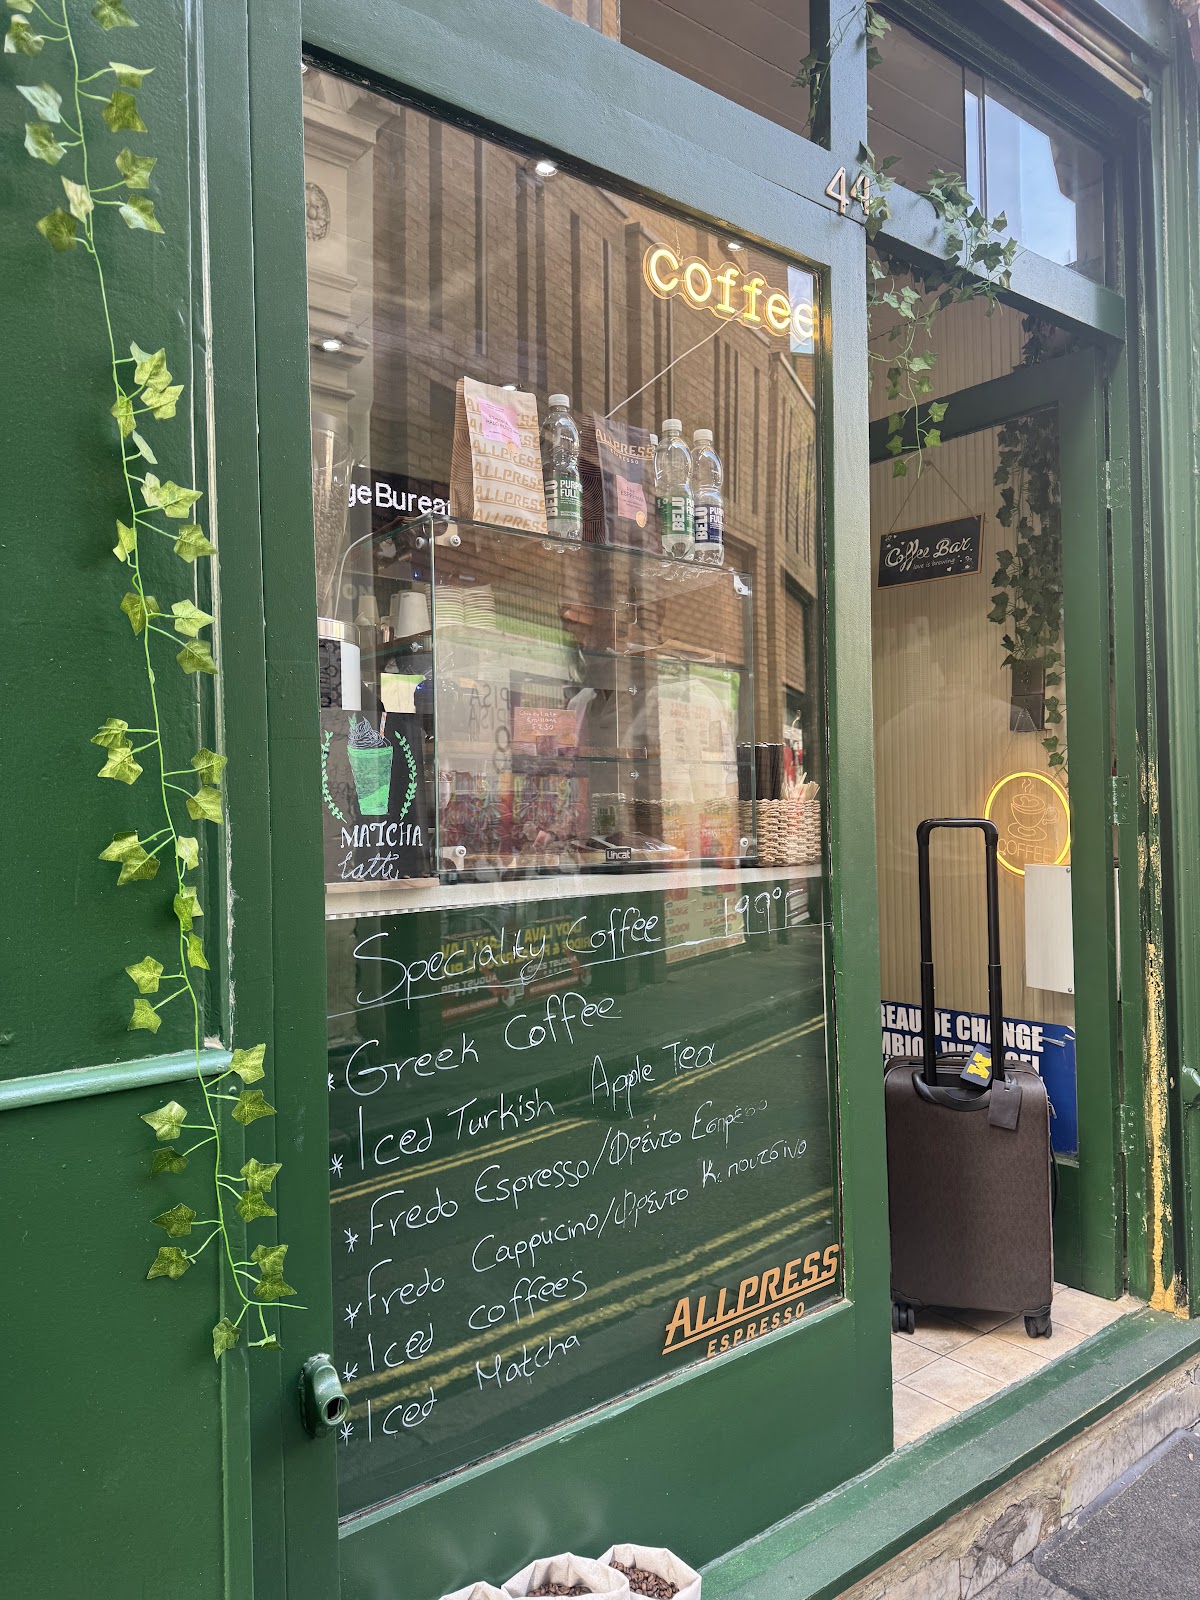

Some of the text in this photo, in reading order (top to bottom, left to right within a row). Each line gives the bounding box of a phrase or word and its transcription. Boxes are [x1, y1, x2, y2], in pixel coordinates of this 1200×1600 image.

[825, 166, 870, 216] 44
[649, 248, 817, 339] Coffee
[596, 429, 655, 460] ALLPRESS
[474, 461, 544, 492] ALLPRESS
[475, 485, 546, 513] ALLPRESS
[545, 480, 558, 517] BELU
[672, 496, 685, 531] BELU
[474, 508, 547, 532] ALLPRESS
[695, 506, 708, 541] BELU
[885, 538, 930, 573] Coffee
[925, 560, 931, 568] is
[931, 557, 956, 567] brewing
[340, 820, 423, 848] MATCHA
[606, 849, 631, 860] Lincat
[353, 927, 546, 1009] Speciality
[569, 908, 662, 960] Coffee
[346, 992, 622, 1096] Greek Coffee
[358, 1041, 716, 1171] Iced Turkish Apple Tea
[369, 1190, 458, 1246] Fredo
[367, 1259, 445, 1315] Fredo
[662, 1243, 840, 1355] ALLPRESS
[367, 1324, 434, 1372] Iced
[706, 1301, 805, 1359] ESPRESSO
[367, 1332, 581, 1442] Iced Matcha
